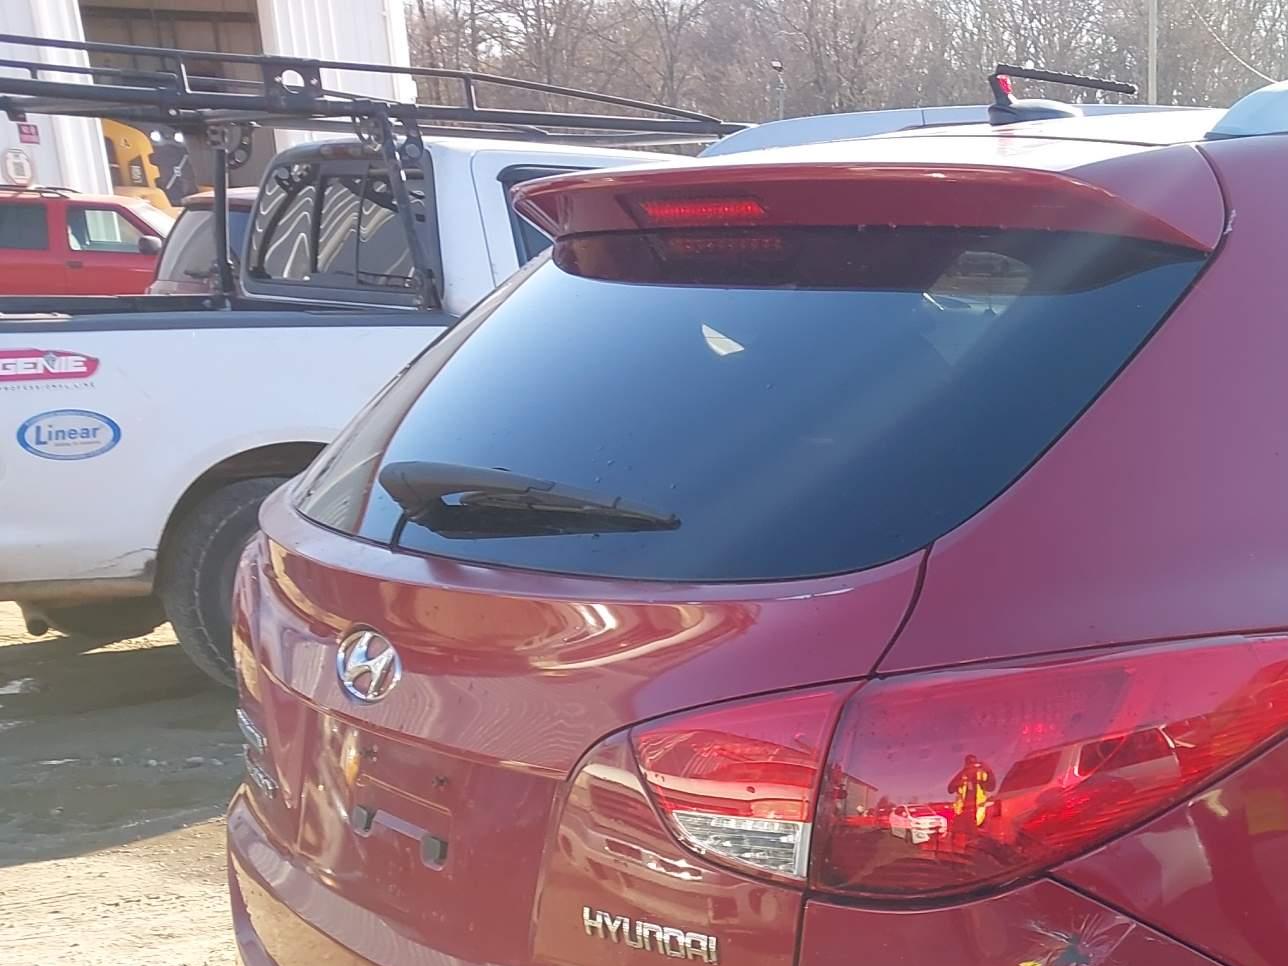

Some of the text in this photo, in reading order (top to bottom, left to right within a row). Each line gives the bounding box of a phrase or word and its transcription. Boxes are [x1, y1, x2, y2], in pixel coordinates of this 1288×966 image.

[0, 355, 87, 376] GENIE
[35, 424, 99, 446] Linear
[582, 905, 719, 965] HYUNDAI
